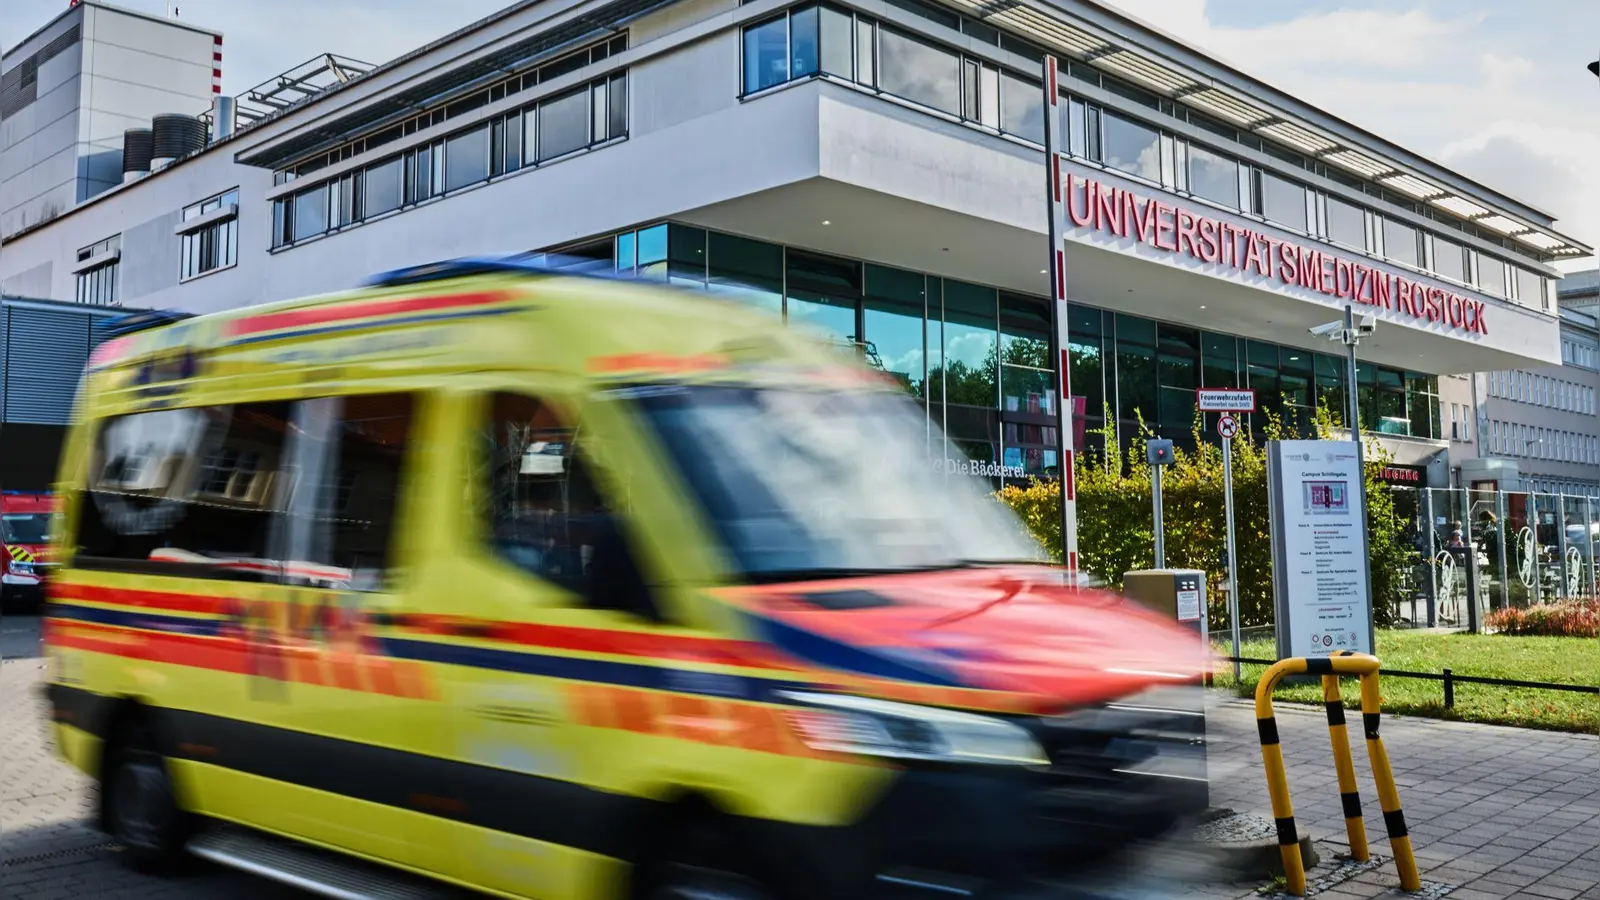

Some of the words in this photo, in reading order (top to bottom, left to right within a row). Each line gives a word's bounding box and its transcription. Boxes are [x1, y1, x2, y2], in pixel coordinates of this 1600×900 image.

[1067, 172, 1391, 310] UNIVERSITÄTSMEDIZIN
[1396, 276, 1489, 335] ROSTOCK
[1200, 393, 1252, 401] Feuerwehrzufahrt
[946, 458, 969, 476] Die
[969, 460, 1028, 478] Bäckerei.
